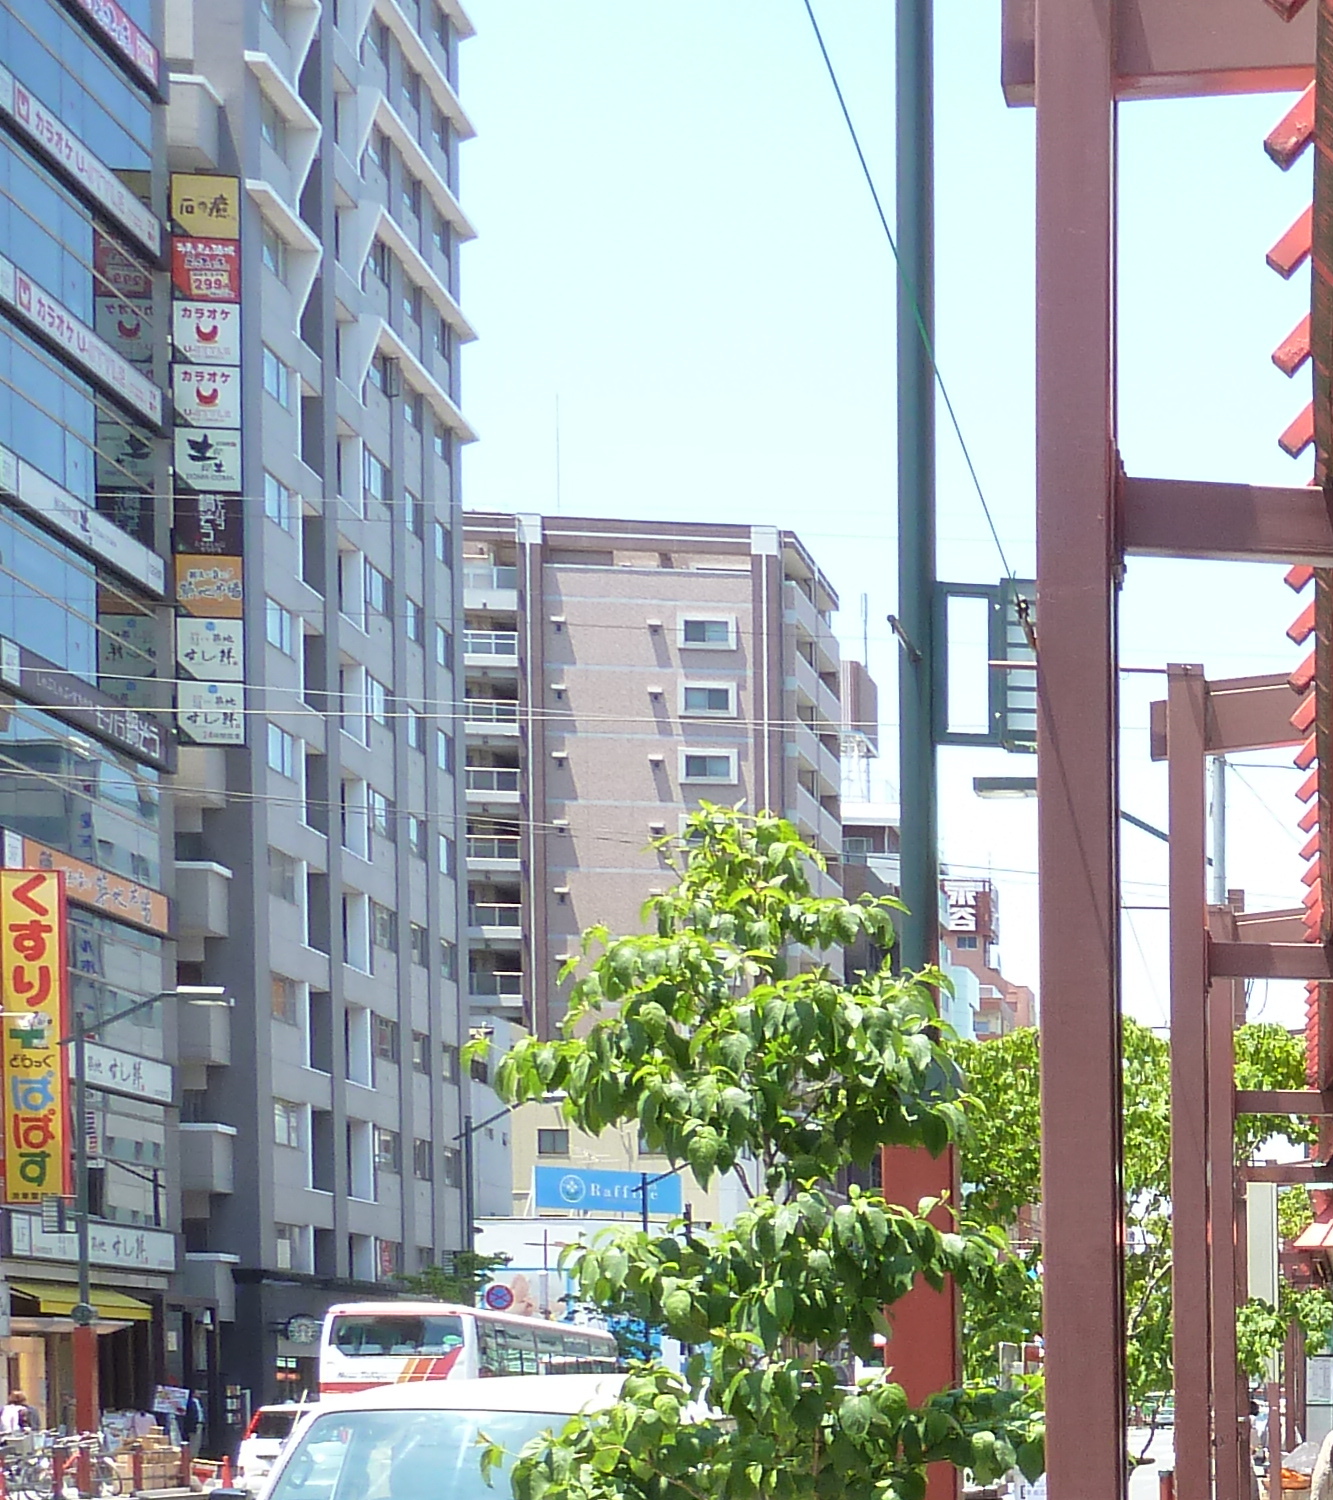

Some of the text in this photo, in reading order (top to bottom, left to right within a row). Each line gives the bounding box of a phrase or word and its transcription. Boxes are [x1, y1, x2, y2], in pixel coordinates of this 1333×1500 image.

[181, 307, 231, 320] カラオケ
[181, 371, 231, 383] カラオケ
[9, 874, 53, 1007] くすり
[9, 1055, 55, 1068] どらっぐ
[11, 1070, 56, 1187] ぱぱす
